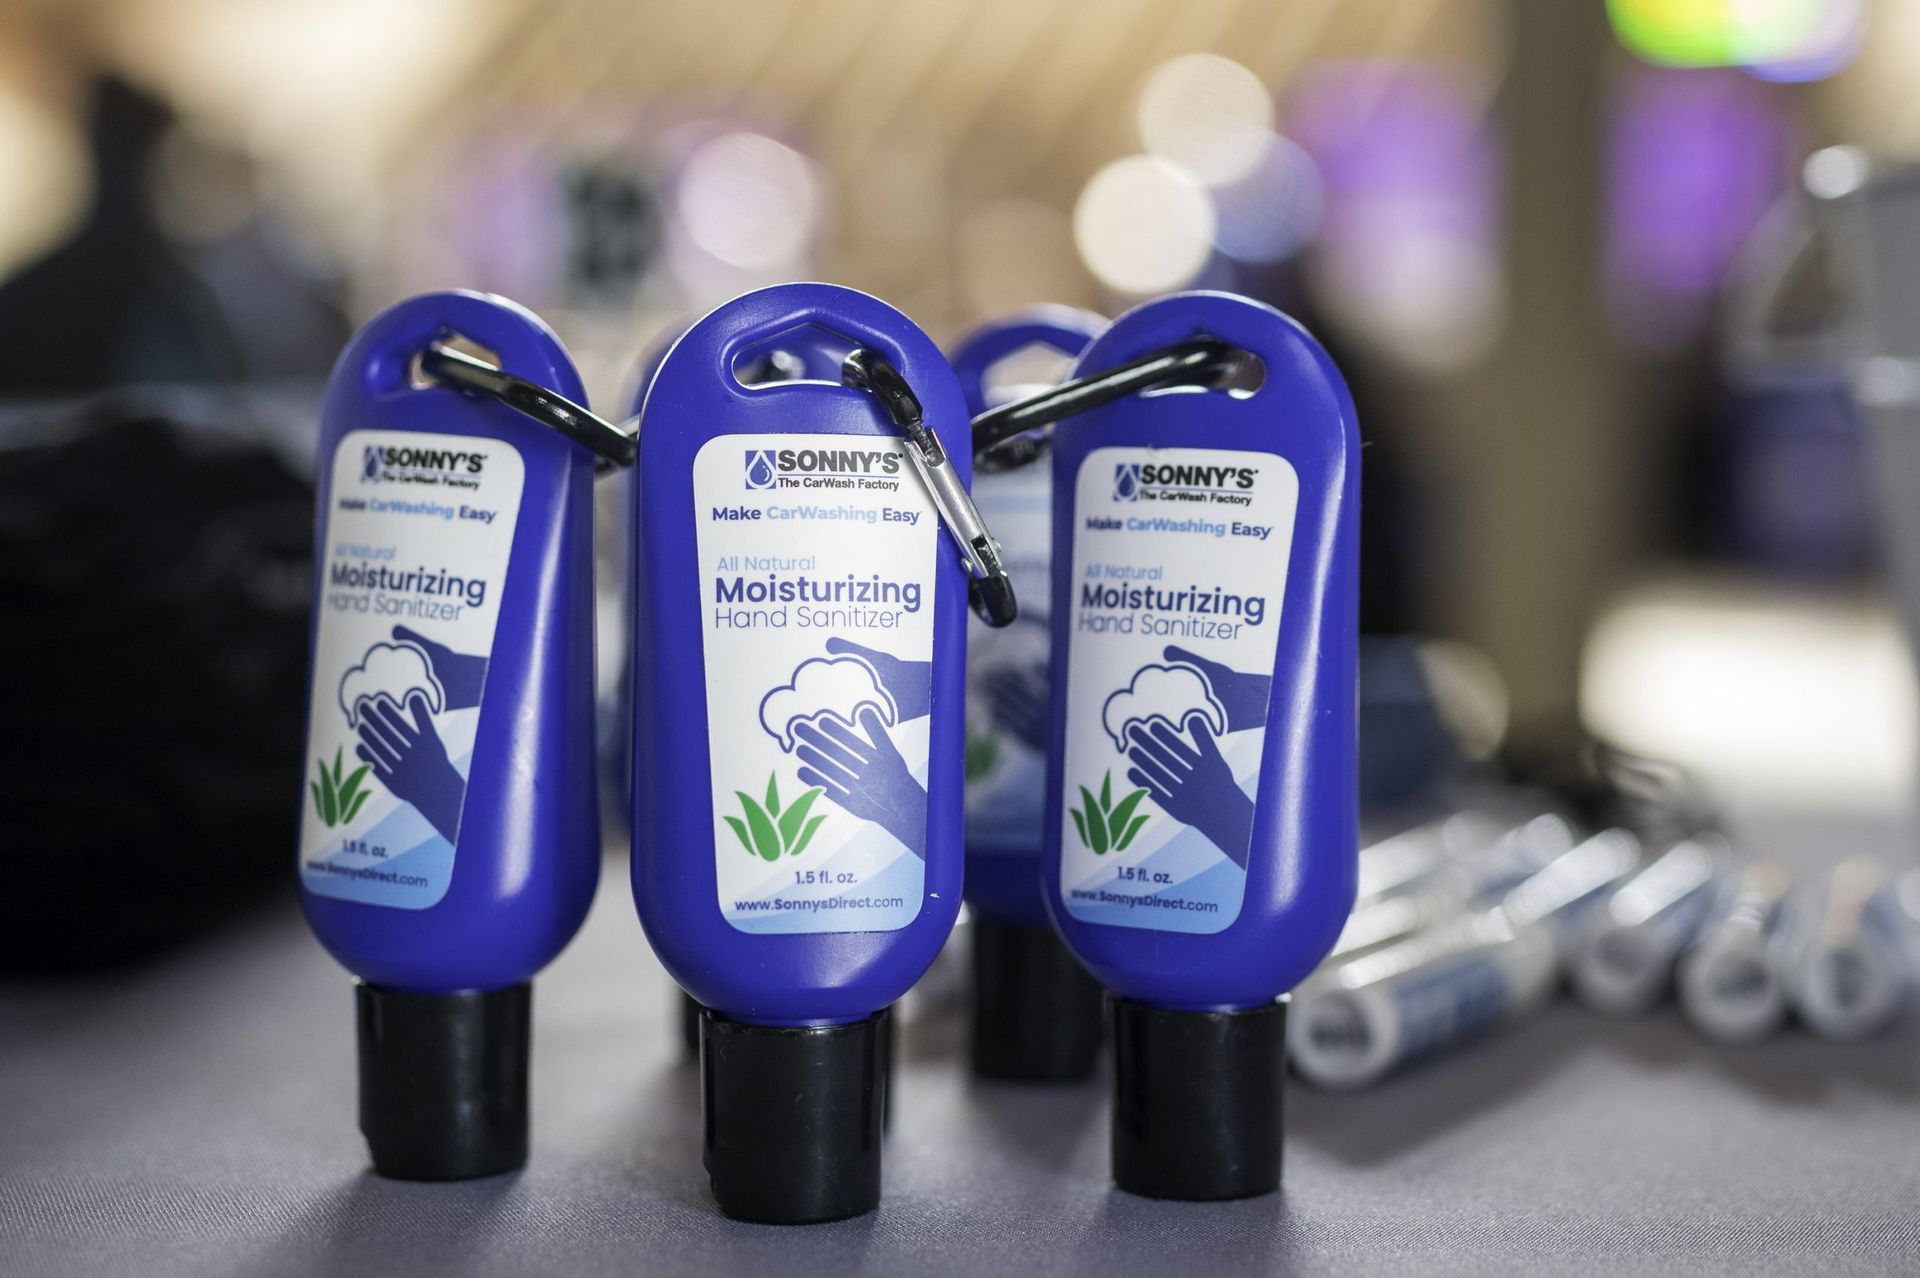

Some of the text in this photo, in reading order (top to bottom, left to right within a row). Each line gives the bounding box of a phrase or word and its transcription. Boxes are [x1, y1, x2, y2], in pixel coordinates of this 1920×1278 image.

[384, 448, 483, 473] SONNY'S
[777, 450, 899, 474] SONNY'S
[778, 477, 899, 492] The CarWash Factory
[1141, 465, 1254, 489] SONNY'S
[1140, 489, 1252, 507] The CarWash Factory
[368, 500, 454, 520] CarWashing
[459, 506, 495, 524] Easy
[712, 506, 920, 525] Make CarWashing Easy
[1086, 517, 1271, 540] Make CarWashing Easy
[717, 555, 816, 571] All Natural
[1085, 565, 1163, 581] All Natural
[331, 561, 486, 607] Moisturizing
[715, 574, 921, 613] Moisturizing
[373, 592, 464, 621] Sanitizer
[1082, 582, 1265, 626] Moisturizing
[715, 605, 903, 628] Hand Sanitizer
[1079, 613, 1242, 640] Hand Sanitizer
[795, 871, 857, 884] 1.5 fl. oz.
[1118, 866, 1173, 884] 1.5 fl. oz.
[735, 897, 903, 912] www.SonnysDirect.com
[1072, 889, 1218, 912] www.SonnysDirect.com
